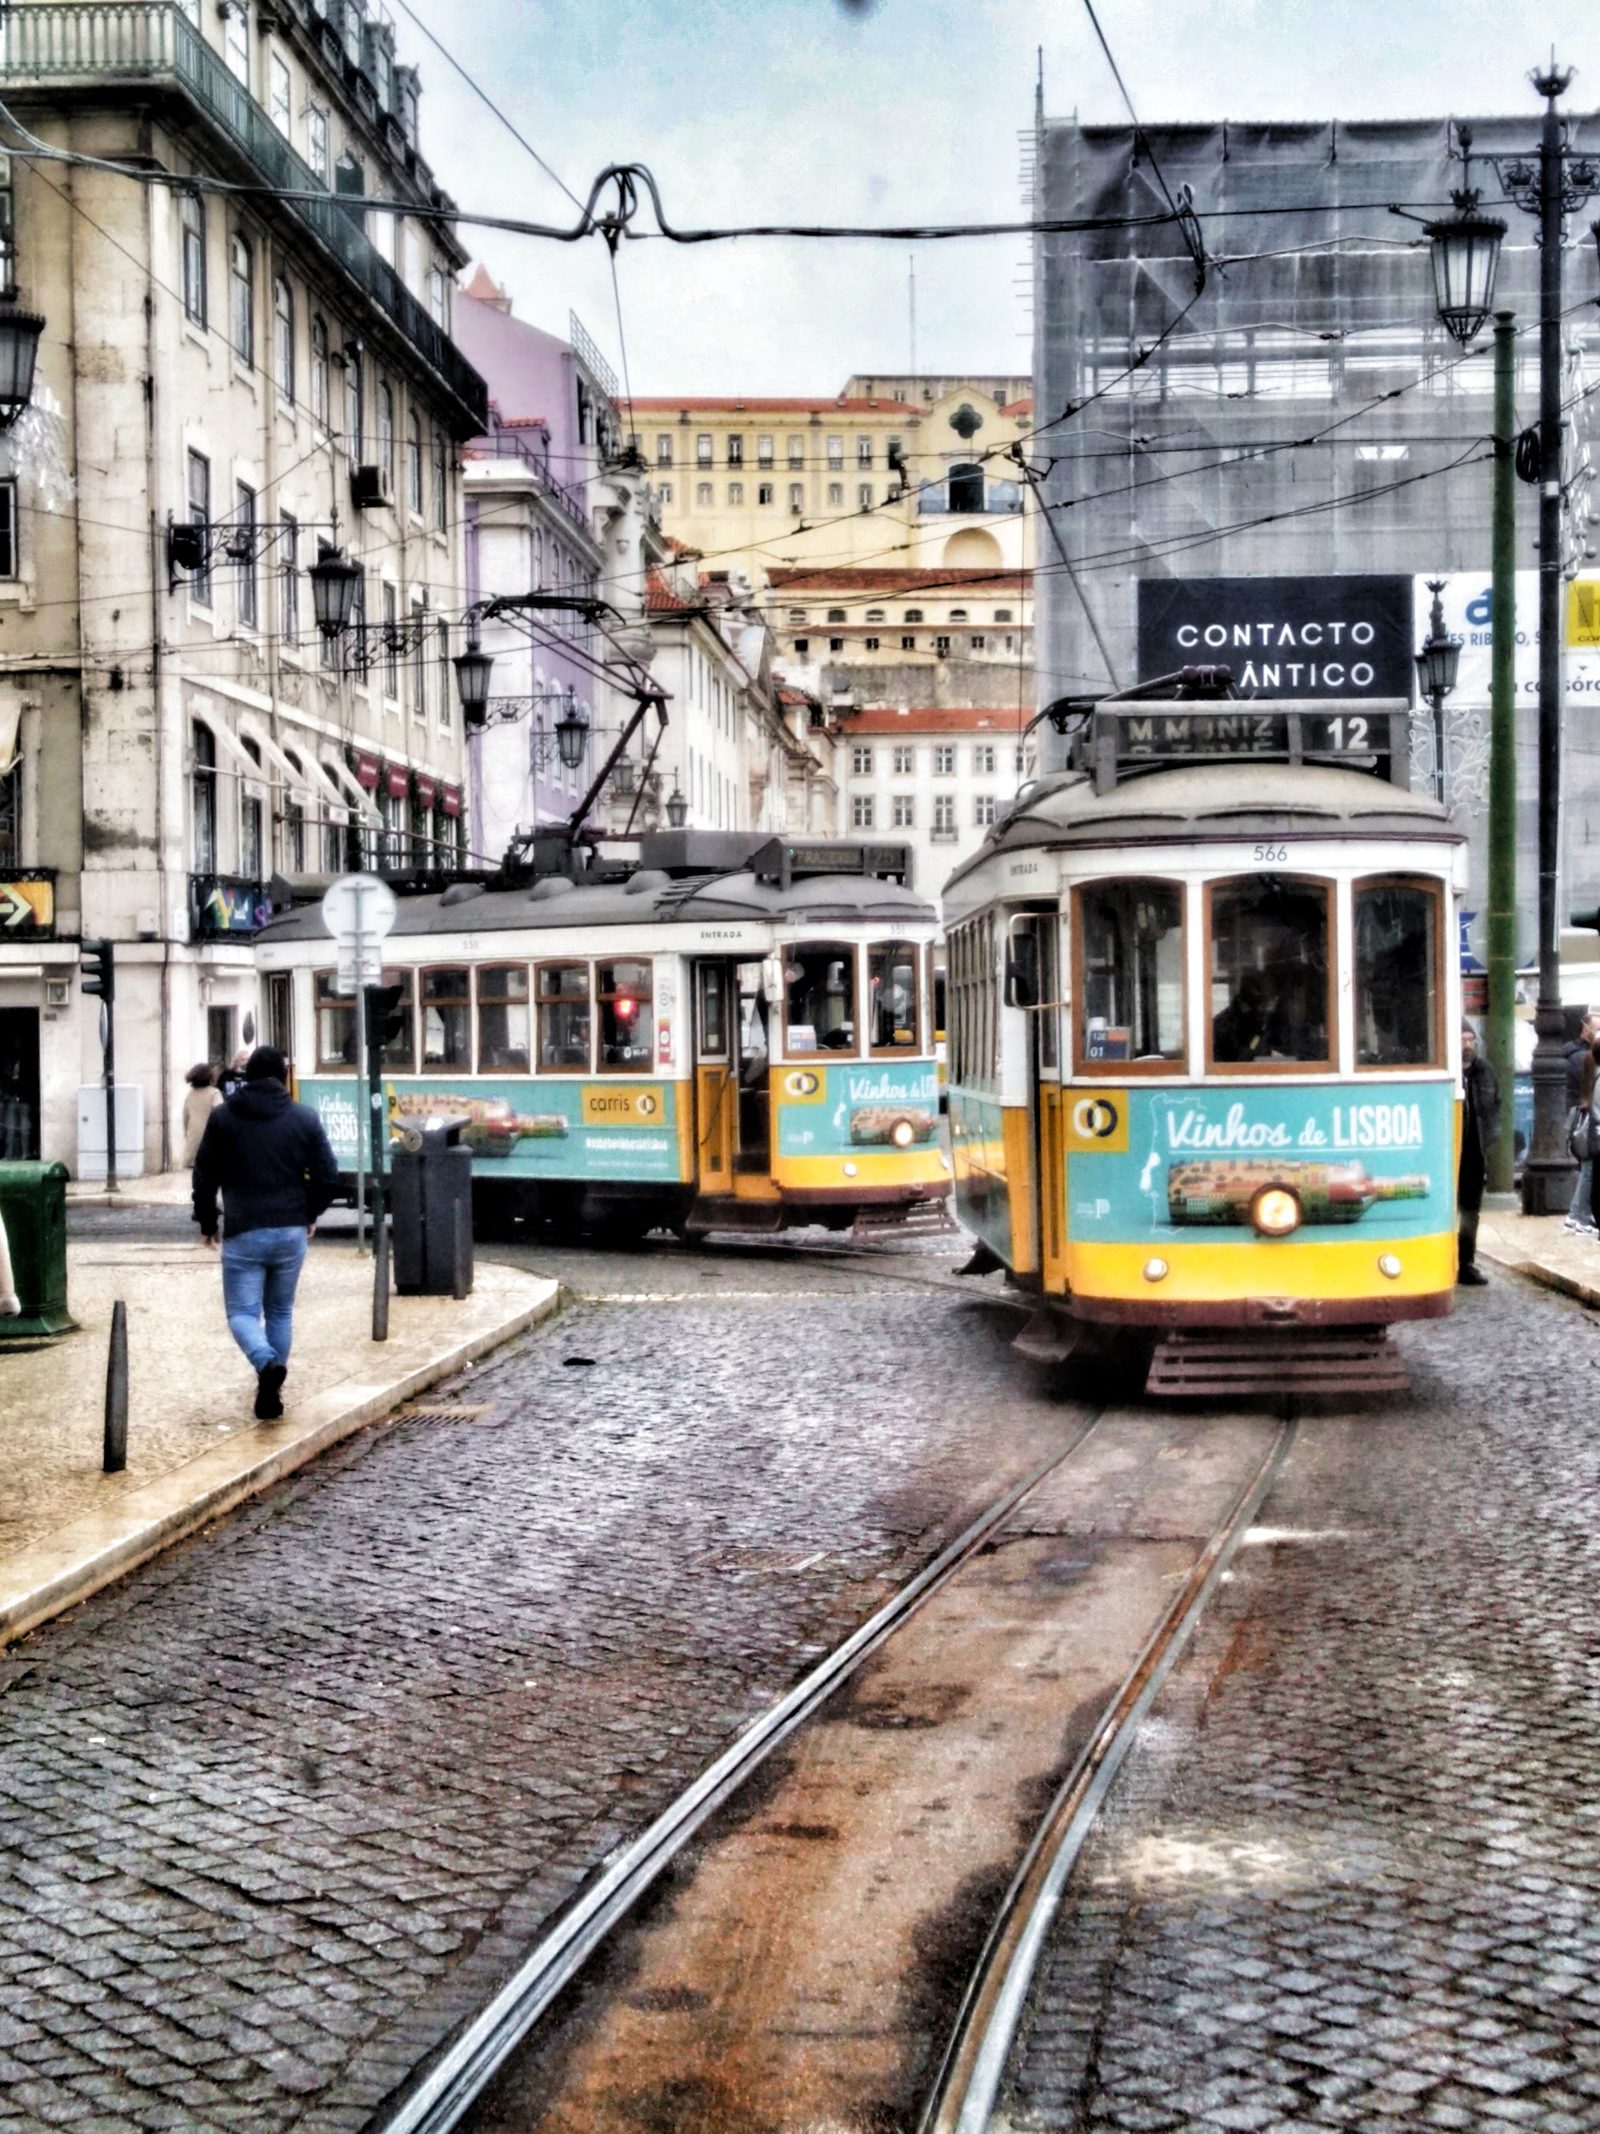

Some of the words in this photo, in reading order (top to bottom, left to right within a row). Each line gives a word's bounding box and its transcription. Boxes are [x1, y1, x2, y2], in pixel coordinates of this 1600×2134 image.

[1177, 622, 1375, 647] CONTACTO
[1471, 632, 1530, 646] RIBO,
[1238, 660, 1375, 687] ÂNTICO
[1327, 717, 1369, 750] 12
[1254, 845, 1288, 862] 566
[700, 930, 742, 939] ENTRADA
[1090, 1046, 1104, 1058] 01
[849, 1072, 908, 1101] Vinhos
[590, 1094, 630, 1112] carris
[1167, 1102, 1292, 1148] Vinhos
[1298, 1117, 1327, 1146] de
[1333, 1104, 1422, 1147] LISBOA
